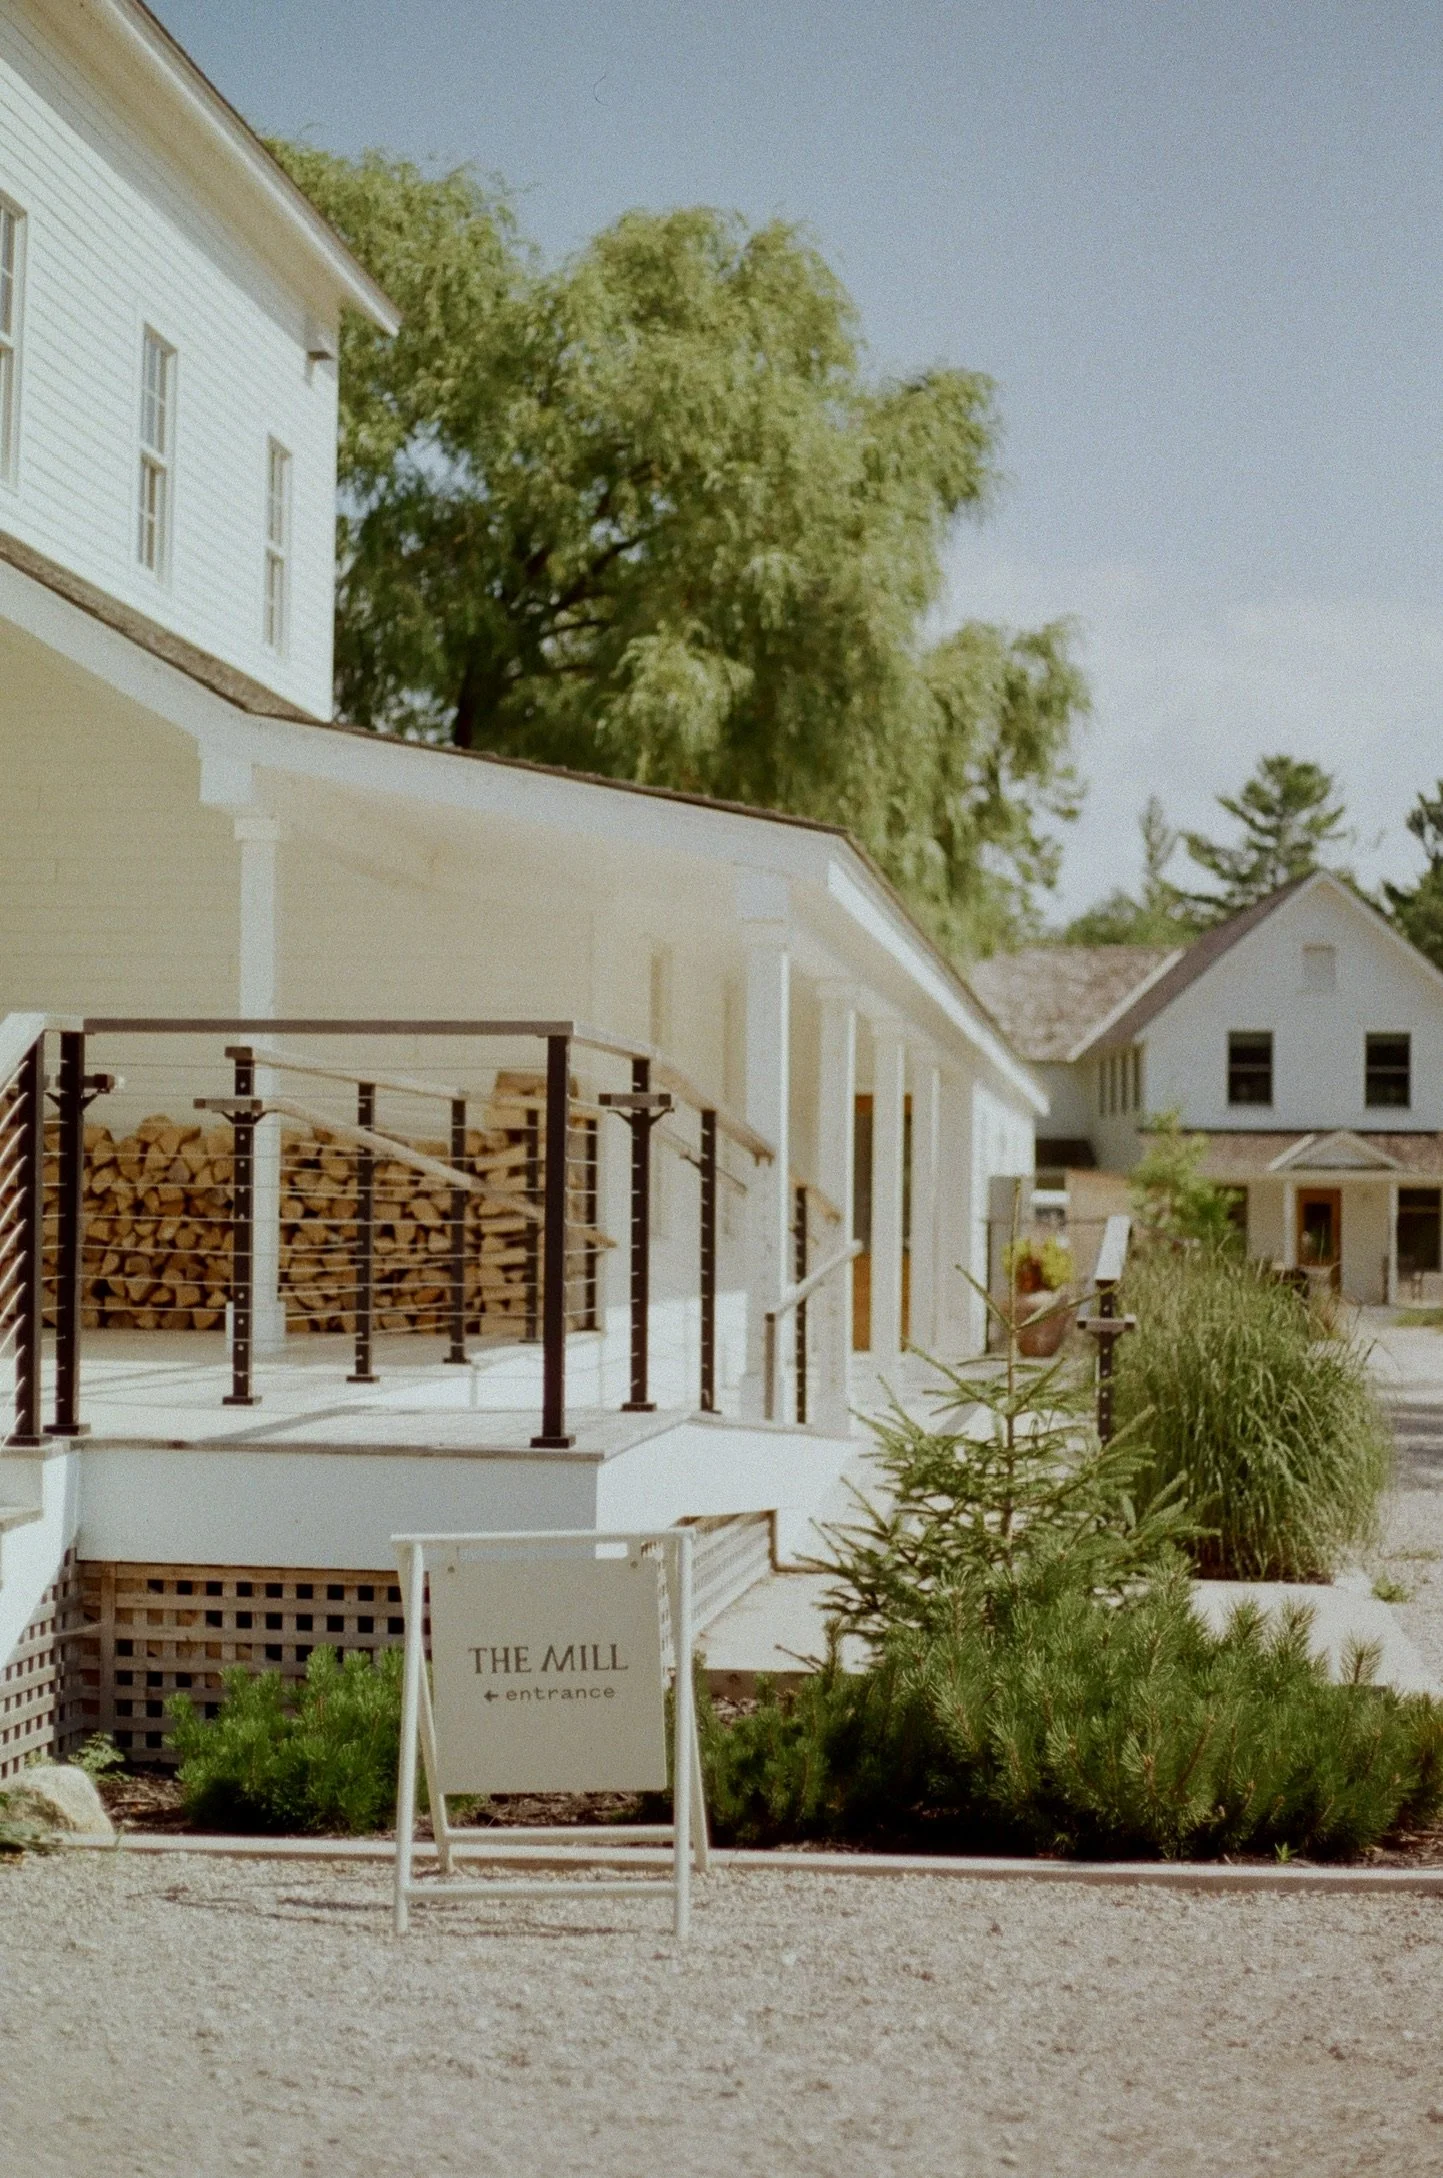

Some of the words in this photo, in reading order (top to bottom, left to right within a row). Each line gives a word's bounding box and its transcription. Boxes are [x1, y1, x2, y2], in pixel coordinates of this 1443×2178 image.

[468, 1646, 531, 1674] THE
[540, 1643, 629, 1672] MILL
[505, 1686, 616, 1701] entrance
